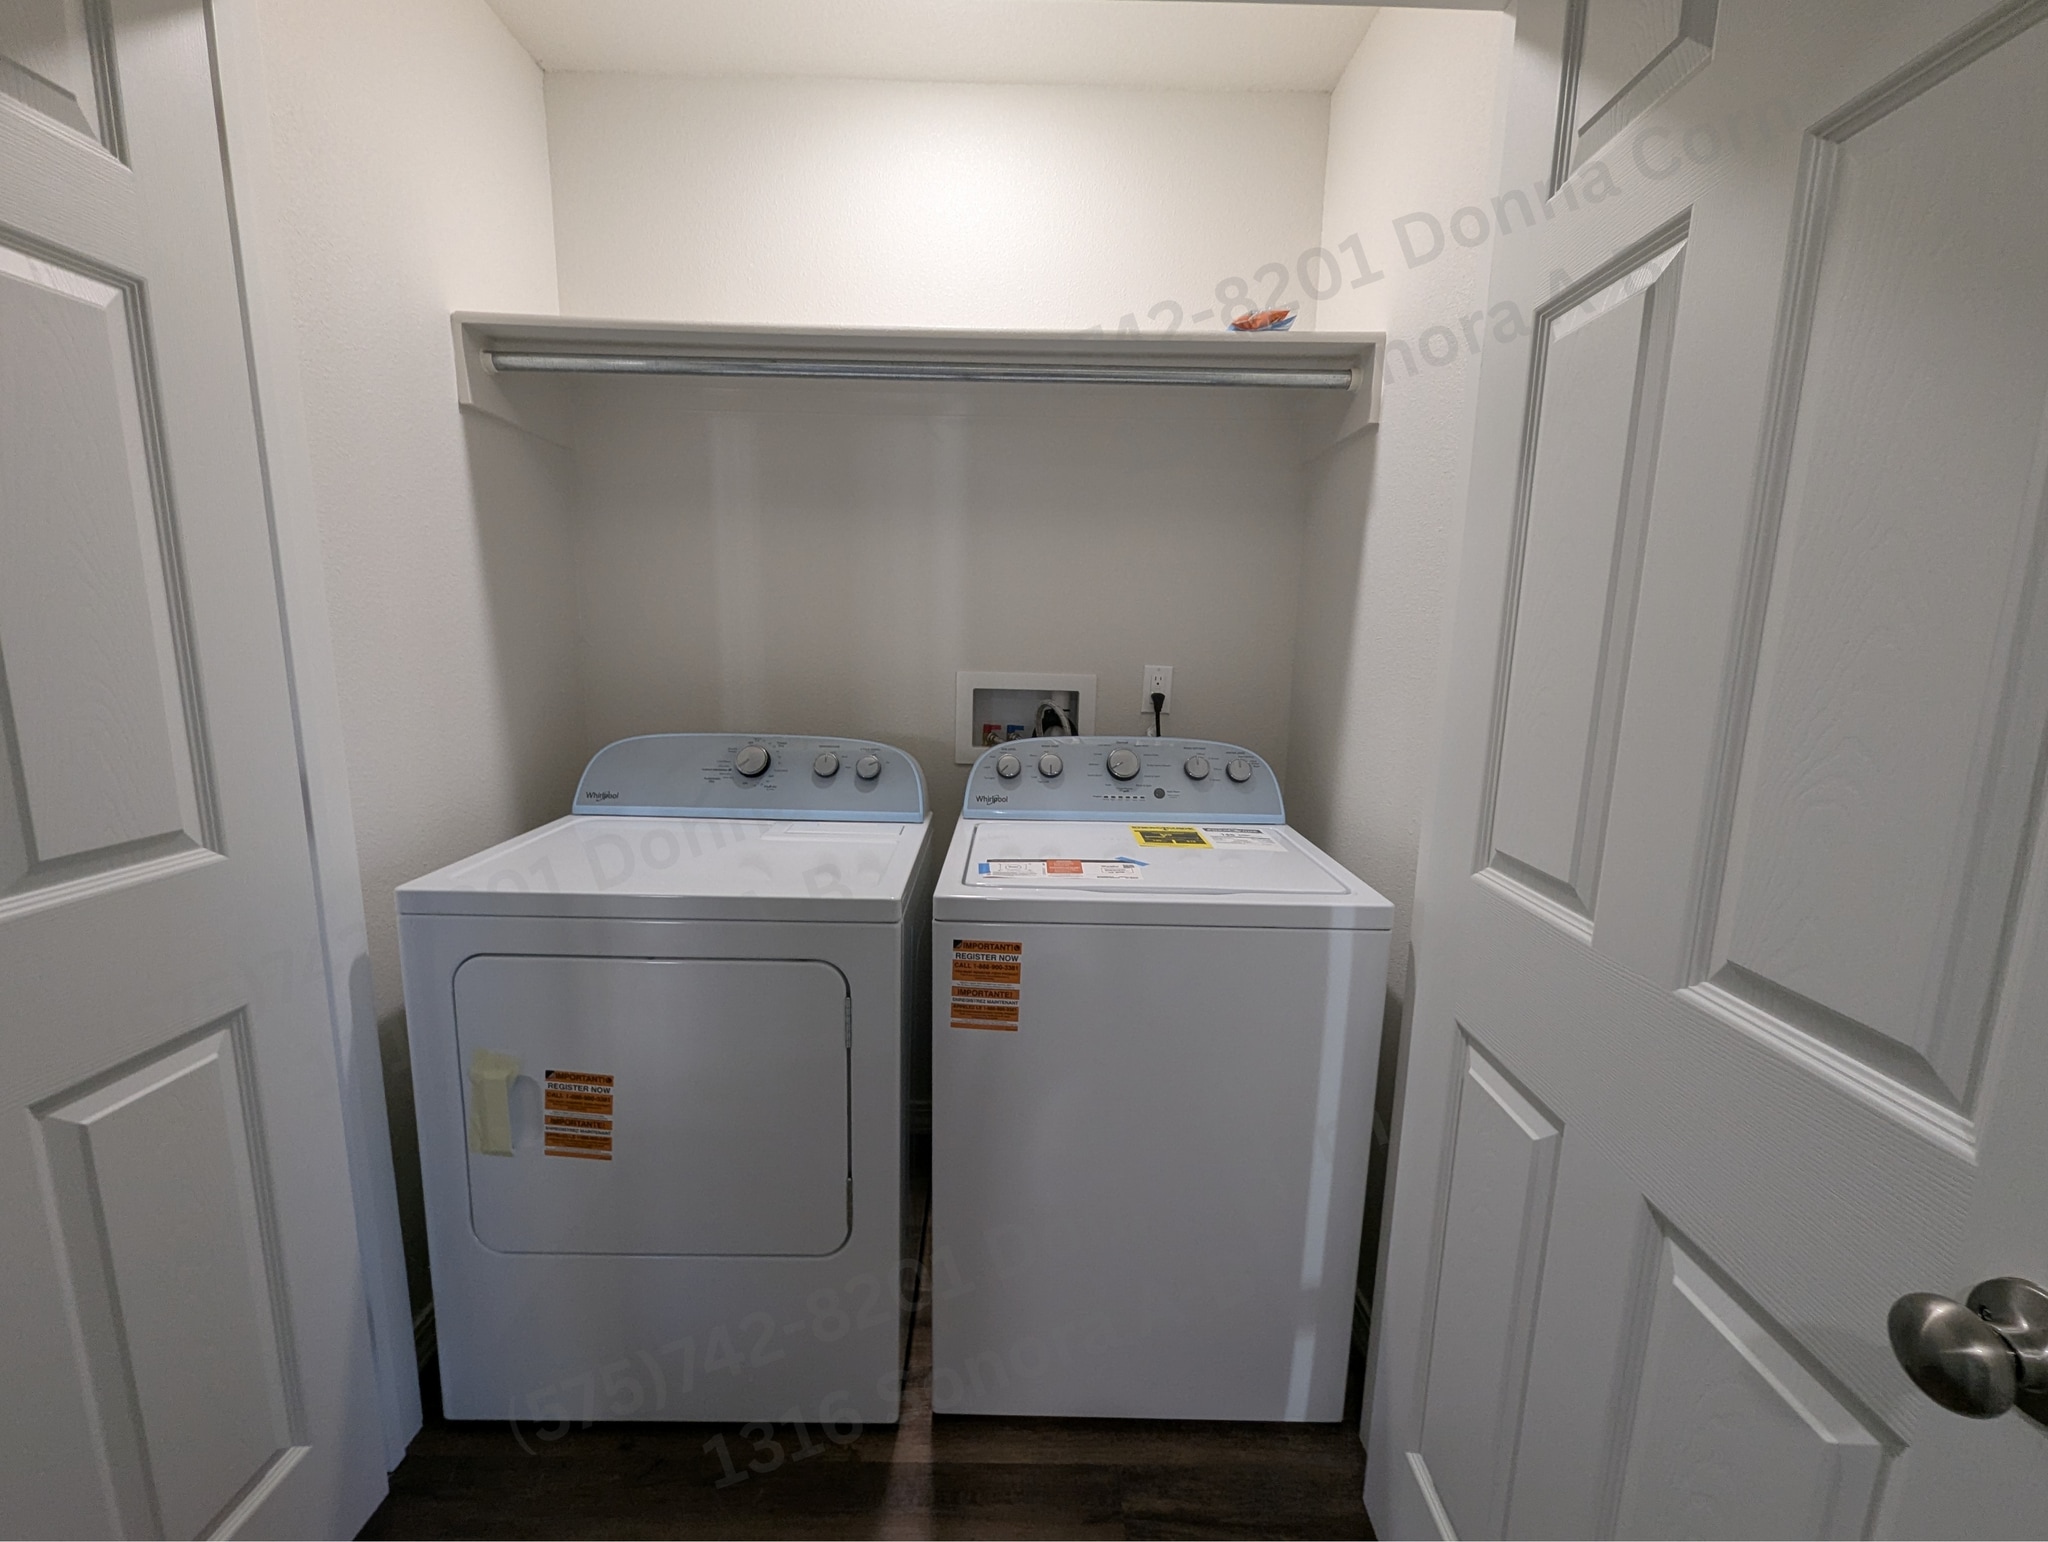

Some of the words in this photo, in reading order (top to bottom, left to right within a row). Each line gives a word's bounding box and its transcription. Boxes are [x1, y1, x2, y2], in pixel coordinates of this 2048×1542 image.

[585, 791, 620, 802] Whirlpool
[975, 794, 1009, 806] Whirlpool
[955, 952, 997, 961] REGISTER
[998, 954, 1020, 962] NOW
[547, 1082, 589, 1092] REGISTER
[590, 1086, 611, 1094] NOW
